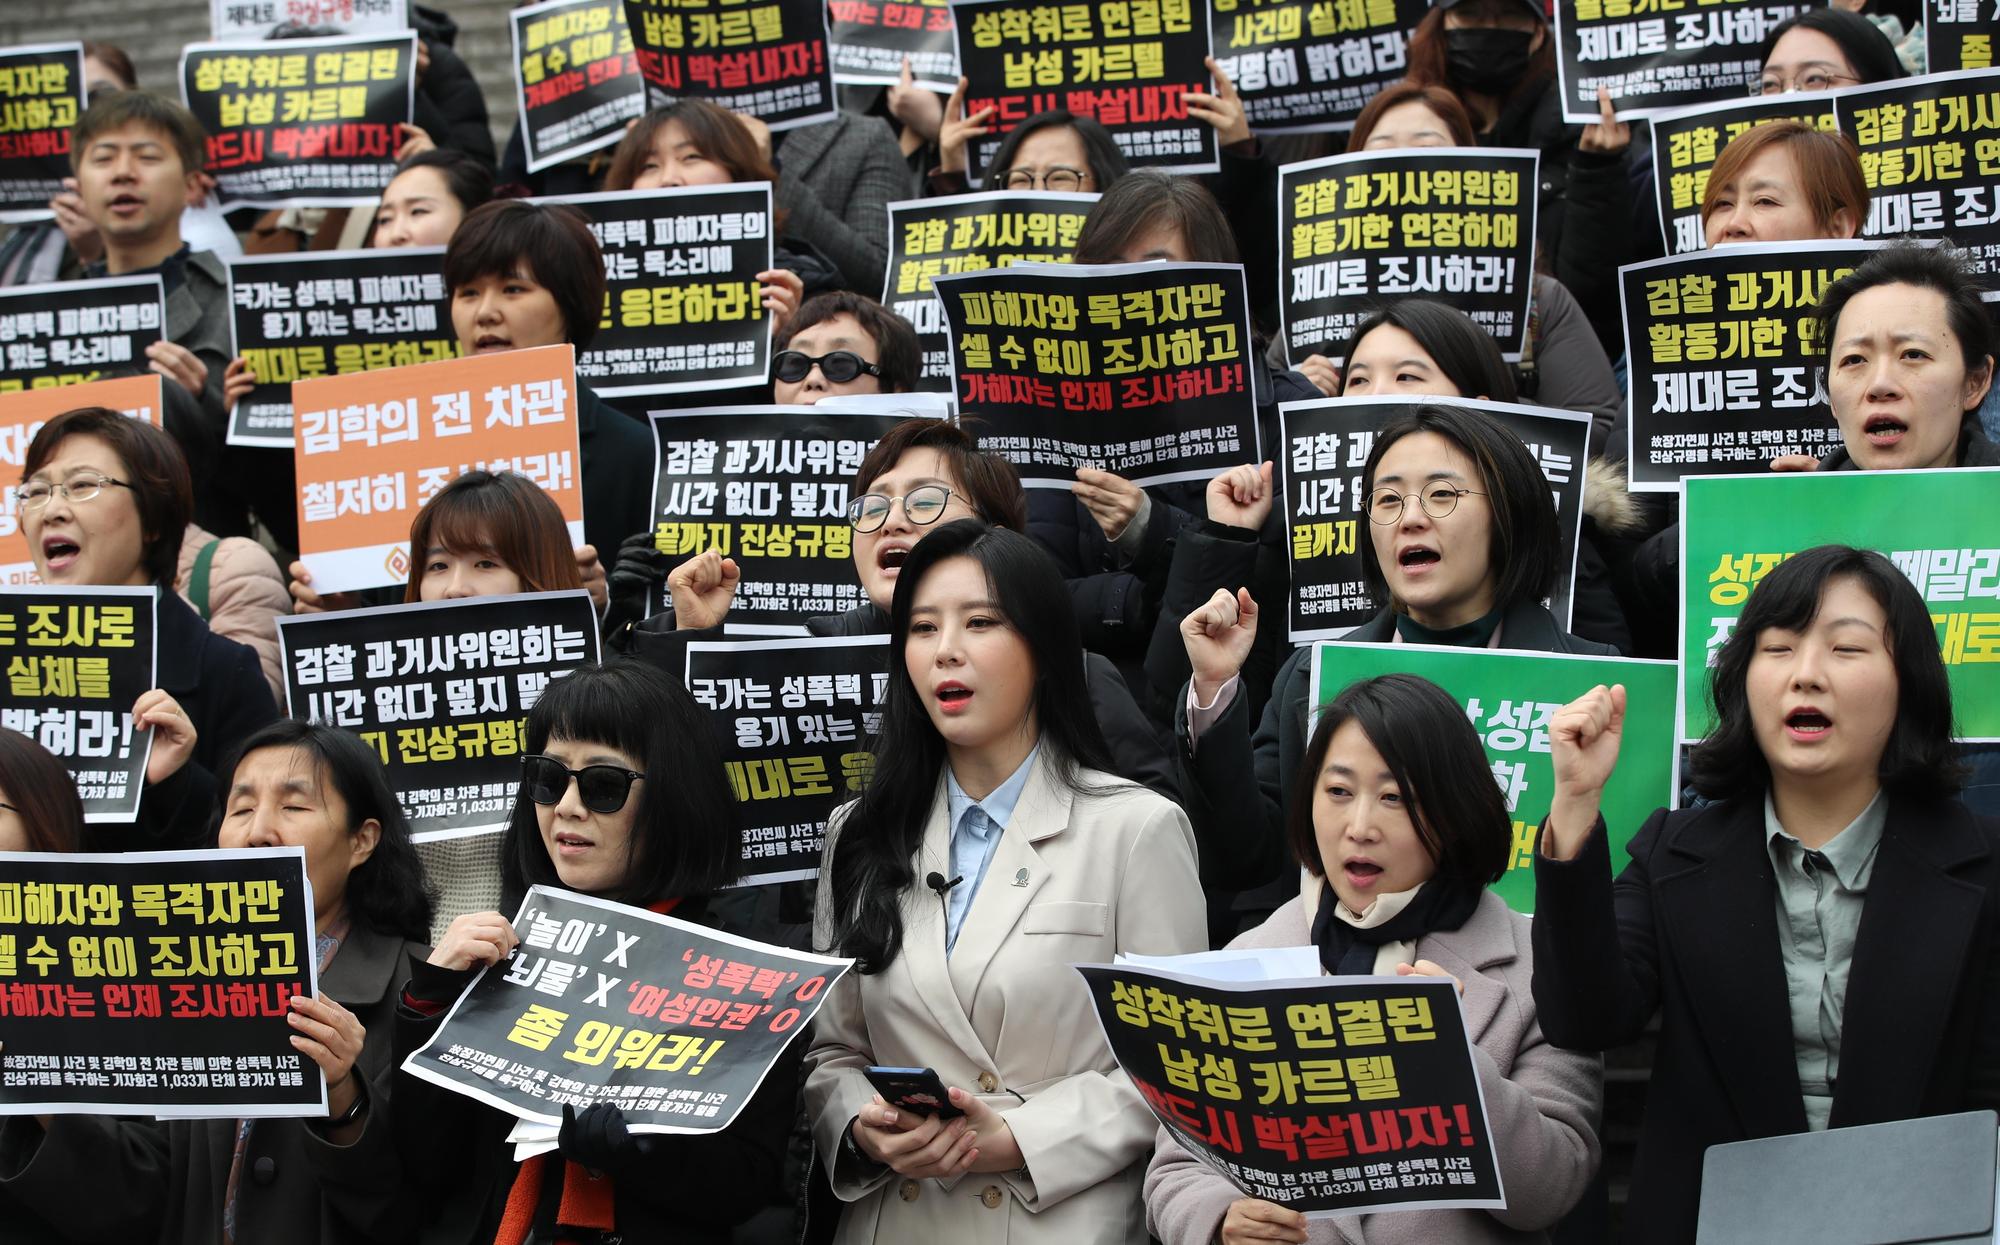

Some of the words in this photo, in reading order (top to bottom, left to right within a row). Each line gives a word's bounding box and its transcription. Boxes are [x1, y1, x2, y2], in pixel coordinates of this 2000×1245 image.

[642, 11, 684, 48] 남성
[690, 5, 783, 47] 카르텔
[971, 4, 1093, 48] 성착취로
[1100, 0, 1192, 39] 연결된
[1230, 6, 1302, 48] 사건의
[1576, 18, 1667, 63] 제대로
[195, 54, 308, 91] 성착취로
[315, 48, 399, 84] 연결된
[688, 40, 823, 89] 박살내자!
[1004, 48, 1064, 89] 남성
[1072, 41, 1164, 84] 카르텔
[220, 91, 276, 128] 남성
[281, 86, 367, 123] 카르텔
[1854, 103, 1906, 146] 검찰
[1669, 129, 1718, 169] 검찰
[1859, 141, 1966, 189] 활동기한
[1294, 178, 1340, 218] 검찰
[1344, 170, 1519, 210] 과거사위원회
[653, 211, 766, 246] 피해자들의
[903, 218, 948, 256] 검찰
[1292, 212, 1393, 260] 활동기한
[1401, 212, 1518, 248] 연장하여
[643, 245, 733, 277] 목소리에
[1291, 257, 1369, 304] 제대로
[1377, 254, 1516, 295] 조사하라!
[233, 281, 292, 310] 국가는
[295, 277, 355, 305] 성폭력
[621, 281, 763, 329] 응답하라!
[959, 290, 1079, 332] 피해자와
[1088, 283, 1226, 329] 목격자만
[1645, 274, 1717, 317] 검찰
[58, 302, 160, 334] 피해자들의
[262, 310, 302, 340] 용기
[307, 309, 349, 337] 있는
[353, 304, 437, 334] 목소리에
[7, 340, 46, 370] 있는
[49, 334, 132, 366] 목소리에
[960, 332, 992, 369] 셀
[999, 335, 1026, 371] 수
[1033, 337, 1091, 377] 없이
[1102, 323, 1240, 376] 조사하고
[1648, 317, 1788, 364] 활동기한
[961, 373, 1056, 409] 가해자는
[1060, 381, 1113, 412] 언제
[1121, 363, 1244, 409] 조사하냐!
[1651, 368, 1761, 414] 제대로
[301, 397, 419, 455] 김학의
[432, 391, 472, 438] 전
[484, 378, 567, 429] 차관
[1712, 432, 1734, 446] 사건
[1751, 430, 1783, 444] 김학의
[1786, 429, 1797, 443] 전
[1801, 429, 1824, 442] 차관
[667, 438, 719, 475] 검찰
[1033, 438, 1051, 450] 사건
[1091, 445, 1101, 458] 전
[1104, 443, 1126, 457] 차관
[1155, 435, 1176, 448] 의한
[1179, 428, 1212, 444] 성폭력
[1215, 425, 1238, 439] 사건
[1110, 451, 1153, 471] 1,033개
[1156, 449, 1178, 462] 단체
[1181, 443, 1215, 458] 참가자
[1291, 431, 1341, 473] 검찰
[1712, 447, 1756, 462] 촉구하는
[302, 472, 406, 522] 철저히
[664, 482, 718, 517] 시간
[725, 481, 782, 517] 없다
[790, 482, 849, 519] 덮지
[1297, 478, 1344, 517] 시간
[655, 522, 731, 557] 끝까지
[1293, 520, 1357, 561] 끝까지
[743, 582, 772, 596] 김학의
[775, 583, 786, 596] 전
[788, 583, 810, 597] 차관
[812, 584, 833, 597] 등에
[836, 584, 857, 598] 의한
[750, 597, 789, 611] 기자회견
[792, 599, 833, 613] 1,033개
[1341, 581, 1356, 597] 사건
[27, 605, 135, 647] 조사로
[294, 643, 356, 685] 검찰
[364, 624, 586, 679] 과거사위원회는
[7, 655, 111, 698] 실체를
[693, 678, 772, 711] 국가는
[779, 673, 862, 709] 성폭력
[307, 688, 366, 727] 시간
[374, 680, 437, 723] 없다
[446, 675, 507, 717] 덮지
[735, 716, 791, 748] 용기
[797, 713, 856, 745] 있는
[108, 770, 128, 784] 사건
[408, 788, 441, 804] 김학의
[444, 786, 455, 801] 전
[457, 785, 480, 800] 차관
[415, 802, 457, 818] 기자회견
[461, 798, 504, 815] 1,033개
[790, 822, 814, 839] 사건
[0, 880, 123, 925] 피해자와
[132, 879, 284, 926] 목격자만
[26, 935, 59, 977] 수
[68, 936, 138, 978] 없이
[149, 932, 299, 978] 조사하고
[603, 932, 641, 969] X
[103, 983, 161, 1018] 언제
[583, 973, 622, 1008] X
[1110, 980, 1277, 1052] 성착취로
[1286, 996, 1436, 1049] 연결된
[505, 1002, 571, 1051] 좀
[562, 1022, 726, 1077] 외워라!
[3, 1055, 60, 1070] 故장자연씨
[63, 1055, 85, 1070] 사건
[88, 1055, 100, 1070] 및
[103, 1056, 137, 1071] 김학의
[140, 1056, 152, 1071] 전
[154, 1056, 178, 1071] 차관
[181, 1056, 205, 1071] 등에
[209, 1056, 233, 1071] 의한
[235, 1056, 271, 1070] 성폭력
[276, 1055, 300, 1070] 사건
[3, 1071, 62, 1087] 진상규명을
[64, 1072, 110, 1087] 촉구하는
[113, 1072, 158, 1088] 기자회견
[161, 1073, 208, 1090] 1,033개
[211, 1073, 236, 1088] 단체
[238, 1072, 275, 1087] 참가자
[279, 1071, 303, 1086] 일동
[506, 1062, 534, 1078] 사건
[584, 1084, 599, 1096] 전
[701, 1092, 728, 1104] 사건
[1156, 1041, 1243, 1102] 남성
[1248, 1055, 1401, 1105] 카르텔
[1252, 1103, 1475, 1163] 박살내자!
[1242, 1165, 1279, 1186] 김학의
[1281, 1173, 1296, 1187] 전
[1299, 1170, 1329, 1186] 차관
[1331, 1166, 1362, 1182] 등에
[1364, 1164, 1393, 1178] 의한
[1396, 1160, 1440, 1175] 성폭력
[1444, 1157, 1471, 1172] 사건
[1255, 1185, 1304, 1202] 기자회견
[1310, 1179, 1366, 1198] 1,033개
[1369, 1176, 1398, 1190] 단체
[1400, 1173, 1445, 1188] 참가자
[1447, 1171, 1477, 1186] 일동
